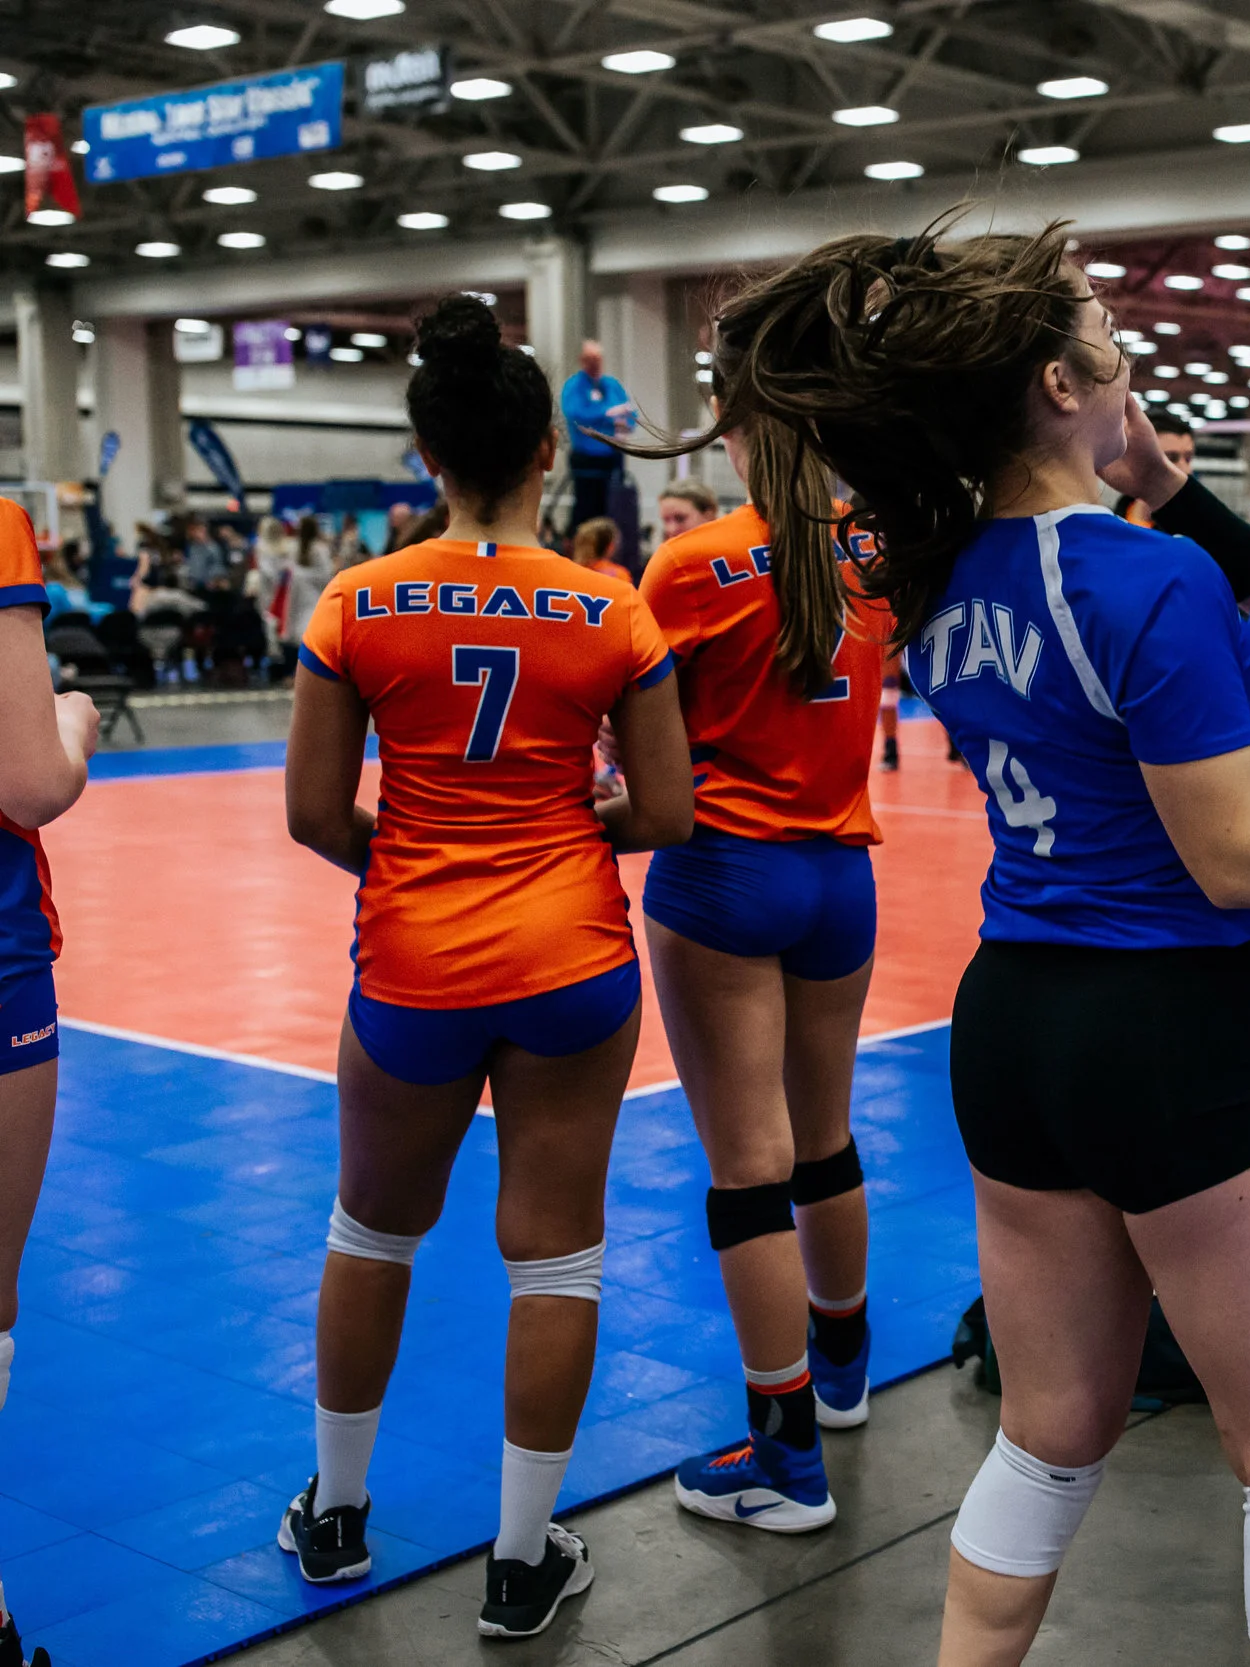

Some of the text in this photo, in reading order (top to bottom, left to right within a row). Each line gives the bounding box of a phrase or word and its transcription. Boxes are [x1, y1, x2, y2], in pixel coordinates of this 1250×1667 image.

[356, 581, 614, 628] LEGACY
[920, 597, 1045, 702] TAV
[452, 644, 520, 763] 7
[986, 738, 1057, 857] 4
[11, 1022, 56, 1048] LEGACY
